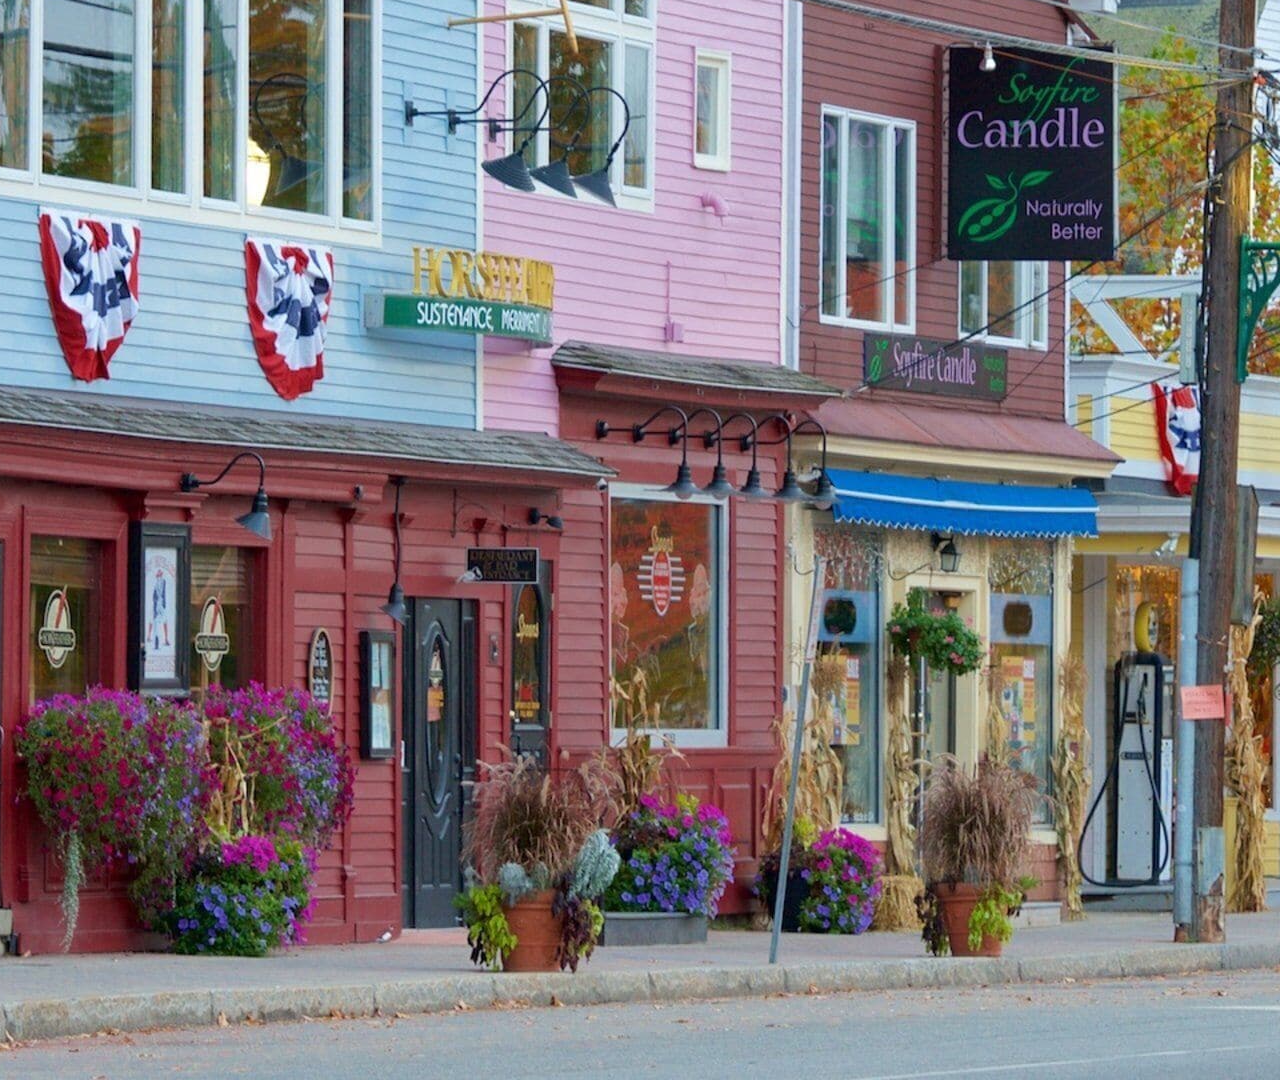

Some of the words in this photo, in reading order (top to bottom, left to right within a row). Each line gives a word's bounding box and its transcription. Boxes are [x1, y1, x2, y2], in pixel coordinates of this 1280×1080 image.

[998, 56, 1100, 134] Soyfire
[957, 107, 1104, 149] Candle
[1025, 199, 1103, 219] Naturally
[1051, 223, 1103, 240] Better
[893, 342, 935, 387] Soyfire
[937, 347, 977, 385] Candle
